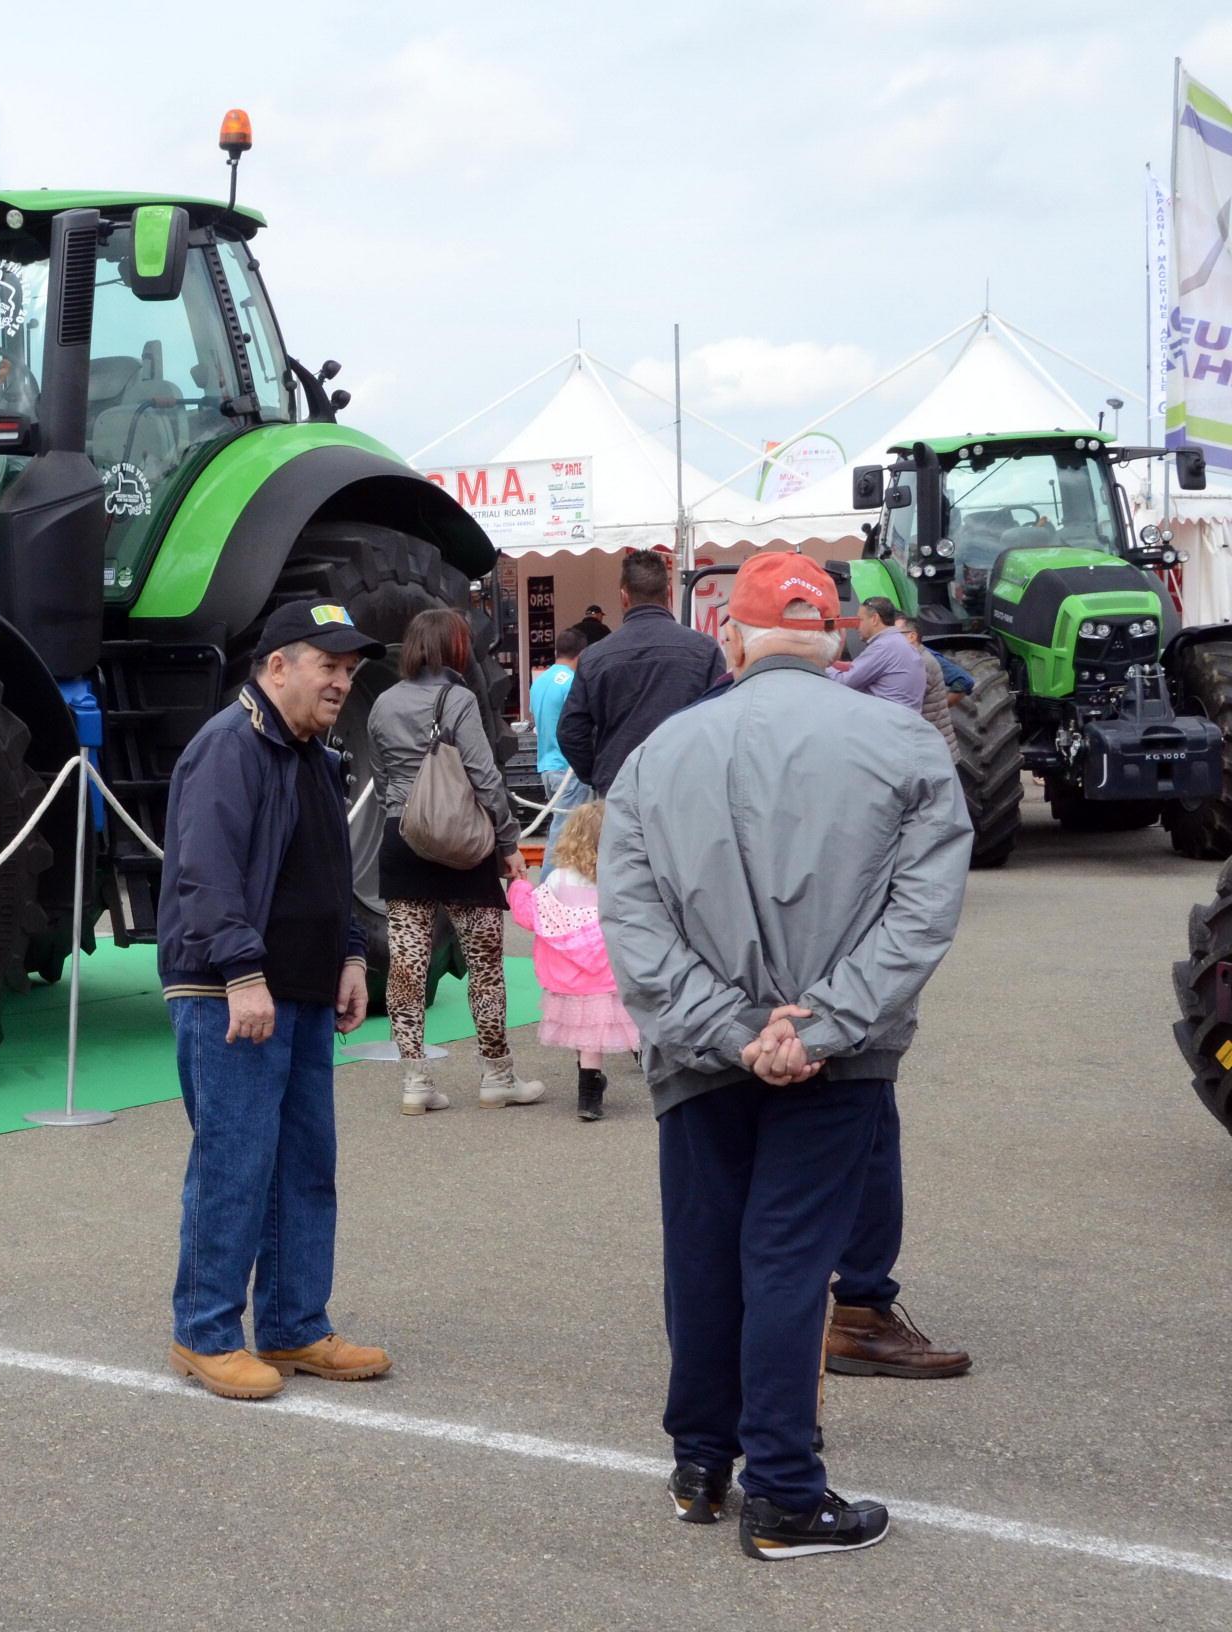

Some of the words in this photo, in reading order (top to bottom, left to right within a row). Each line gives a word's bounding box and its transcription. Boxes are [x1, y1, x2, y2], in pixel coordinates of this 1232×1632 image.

[1158, 256, 1167, 319] MACCHINE
[7, 309, 27, 337] 2015
[112, 464, 120, 473] OF
[122, 463, 135, 473] THE
[505, 508, 536, 517] RICAMBI
[779, 577, 823, 597] GROSSETO
[530, 593, 553, 607] ORSI
[1145, 752, 1160, 761] KG
[1163, 752, 1186, 760] 1000
